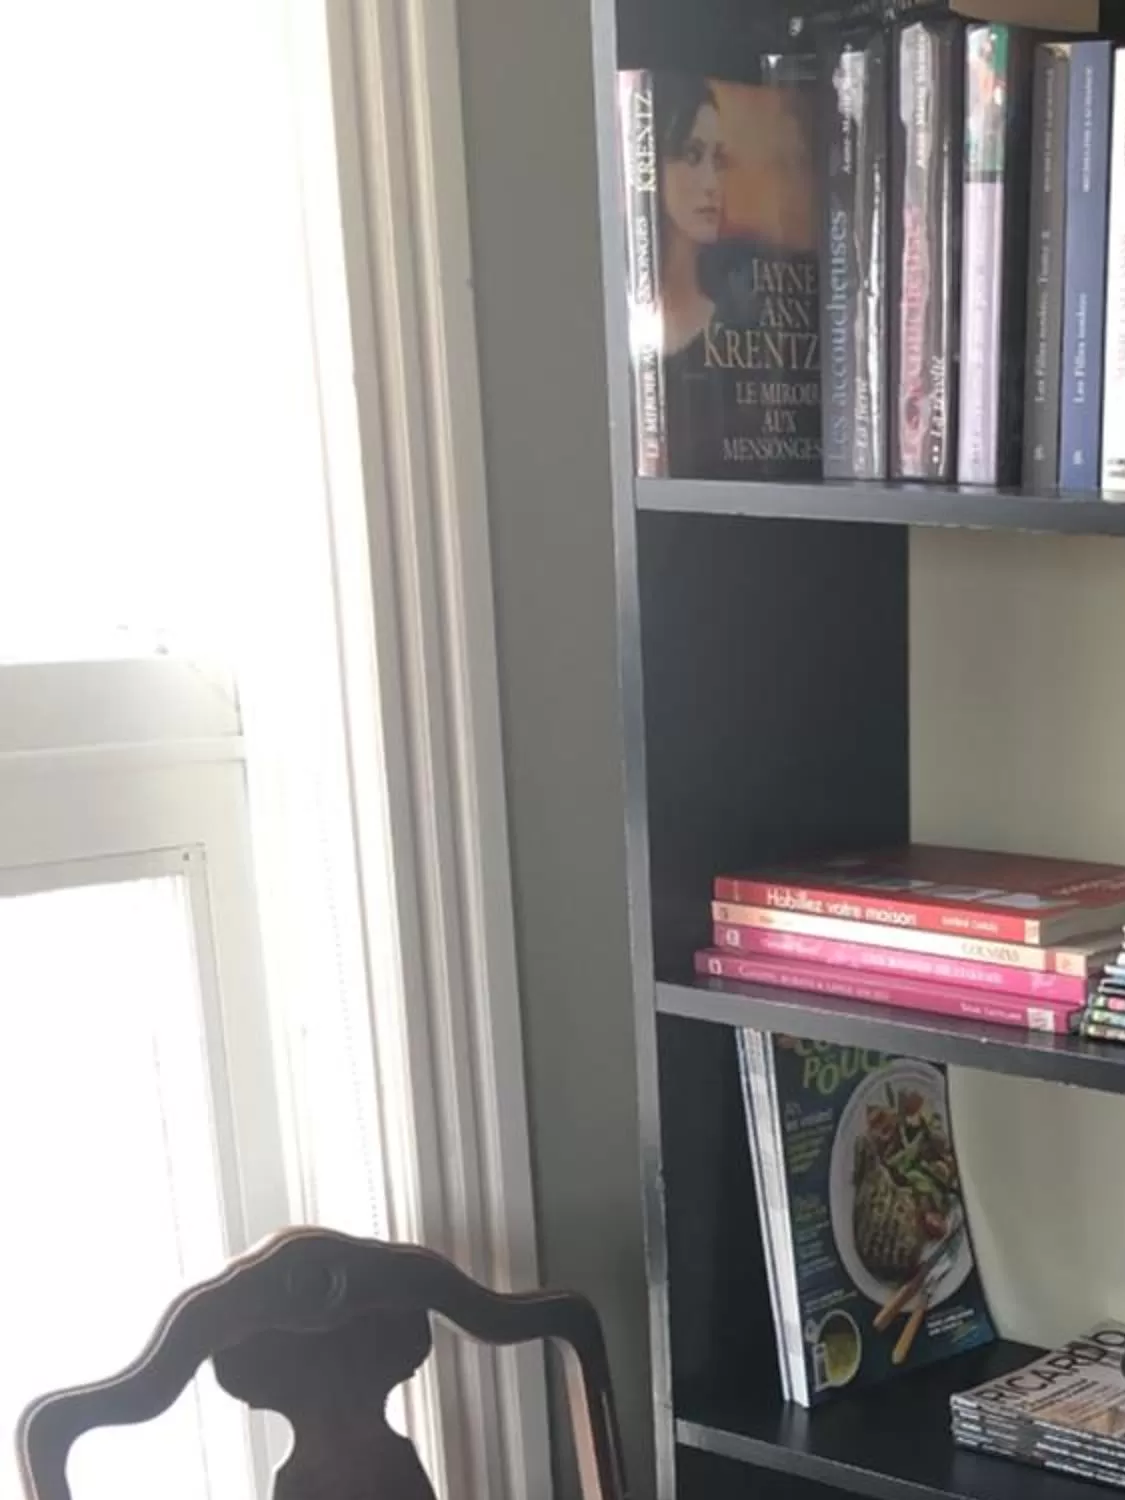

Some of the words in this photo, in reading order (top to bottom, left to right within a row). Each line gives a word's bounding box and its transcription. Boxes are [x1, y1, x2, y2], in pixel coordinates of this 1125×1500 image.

[752, 259, 817, 295] JAYNE
[760, 300, 809, 328] ANN
[827, 211, 848, 408] accoucheuses
[702, 326, 819, 369] KRENTZ
[736, 383, 756, 404] LE
[761, 383, 820, 405] MIROI
[762, 410, 797, 433] AUX
[827, 416, 847, 461] Les
[803, 1046, 890, 1096] POUC
